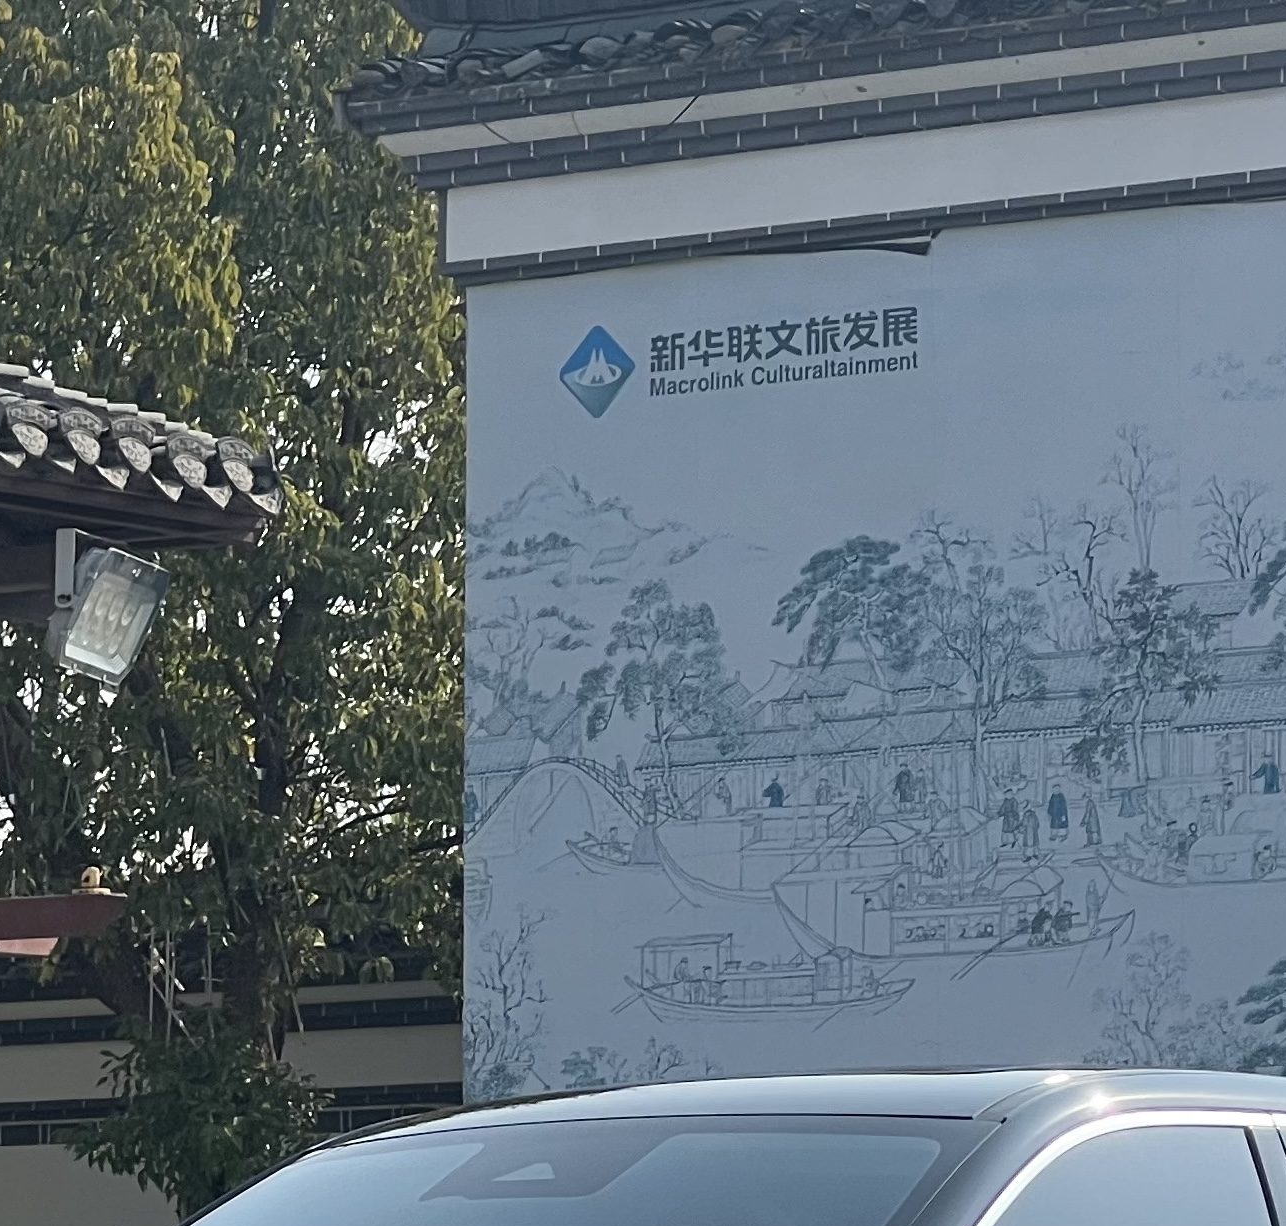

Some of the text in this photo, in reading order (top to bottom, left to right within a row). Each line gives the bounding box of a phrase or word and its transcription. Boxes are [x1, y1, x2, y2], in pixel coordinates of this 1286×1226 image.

[650, 306, 918, 373] 新华联文旅发展
[649, 351, 918, 397] Macrolink Culturaltainment
